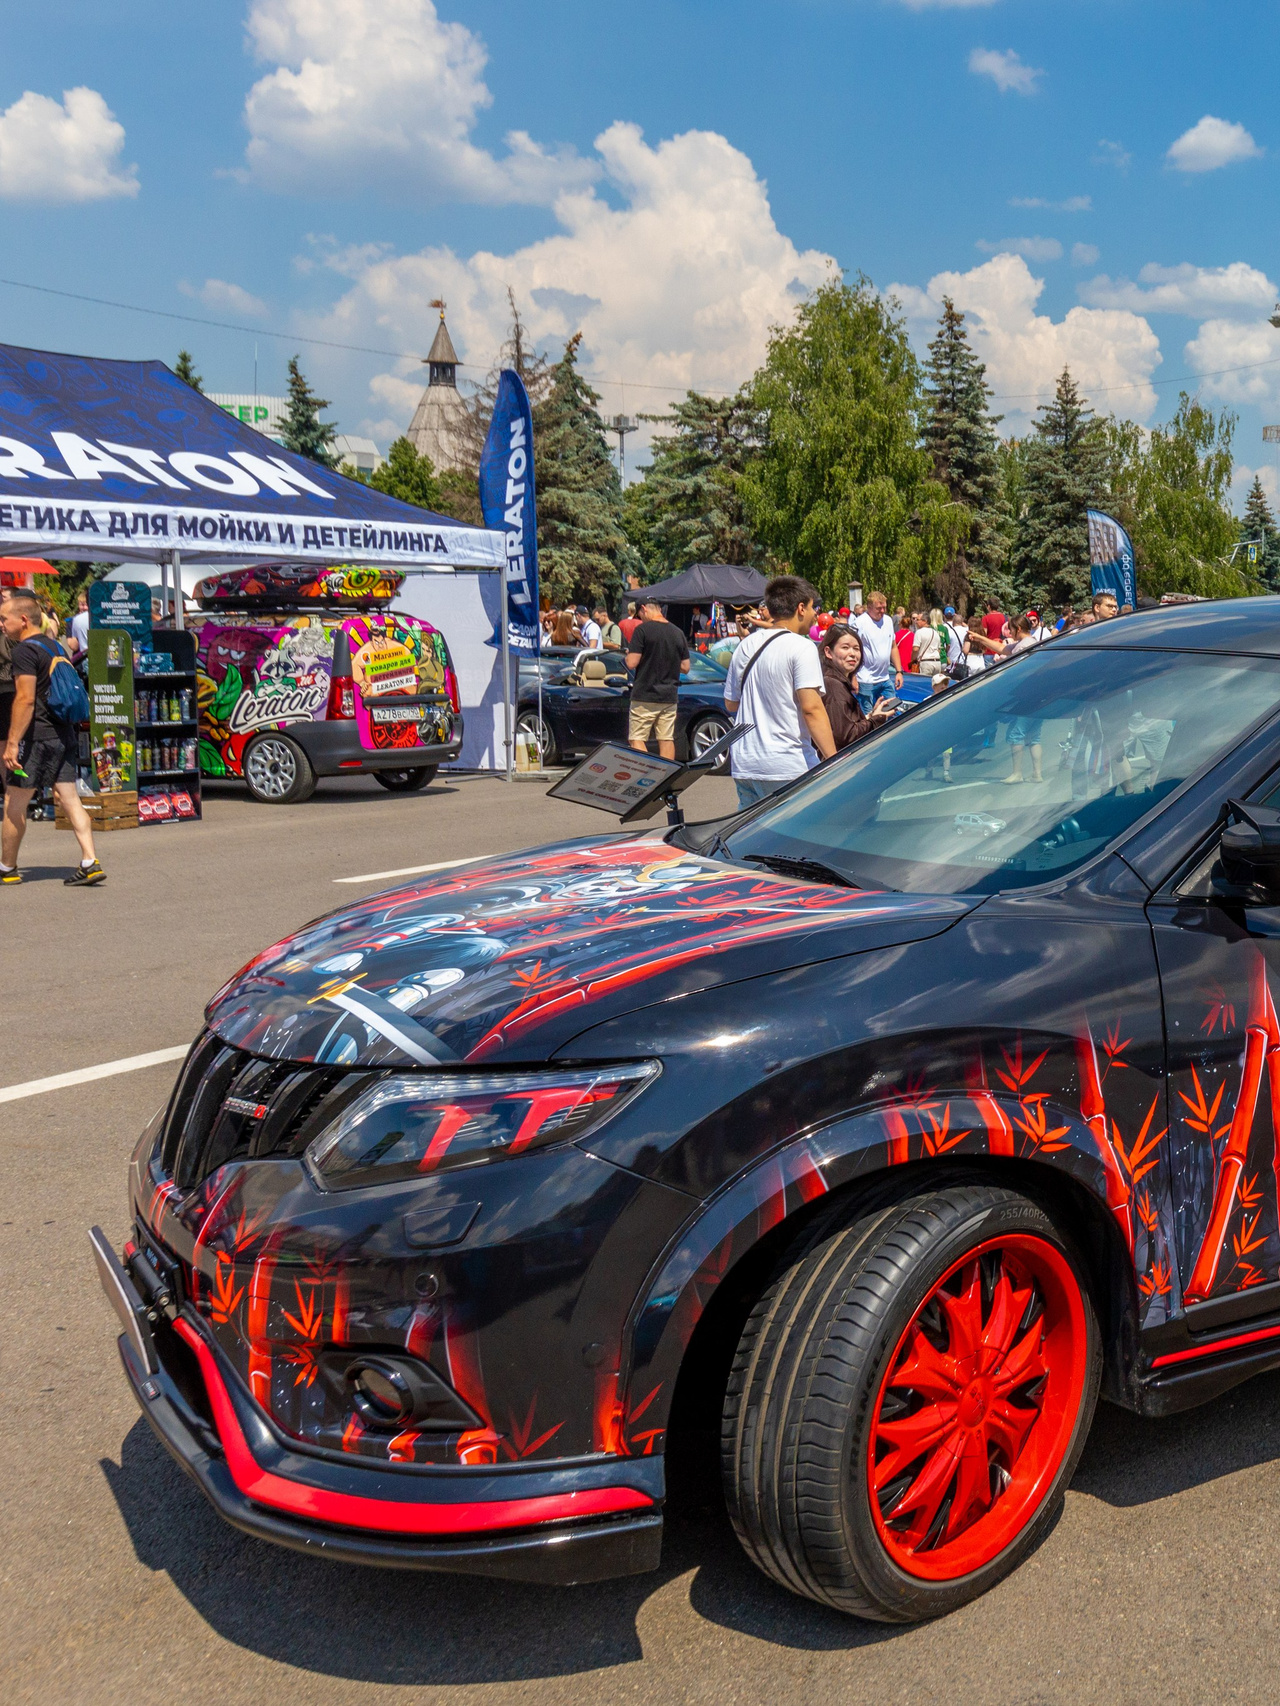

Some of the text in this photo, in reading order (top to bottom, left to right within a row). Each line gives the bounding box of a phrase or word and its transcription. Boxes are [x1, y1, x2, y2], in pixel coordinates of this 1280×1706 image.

[0, 431, 336, 500] RATON
[108, 511, 169, 538] ДЛЯ
[177, 513, 271, 543] МОЙКИ
[277, 523, 296, 545] И
[302, 524, 449, 554] ДЕТЕЙЛИНГА
[504, 416, 532, 606] LERATON
[370, 658, 411, 672] товаров для
[374, 650, 403, 661] Магазин
[230, 687, 321, 731] Leraton
